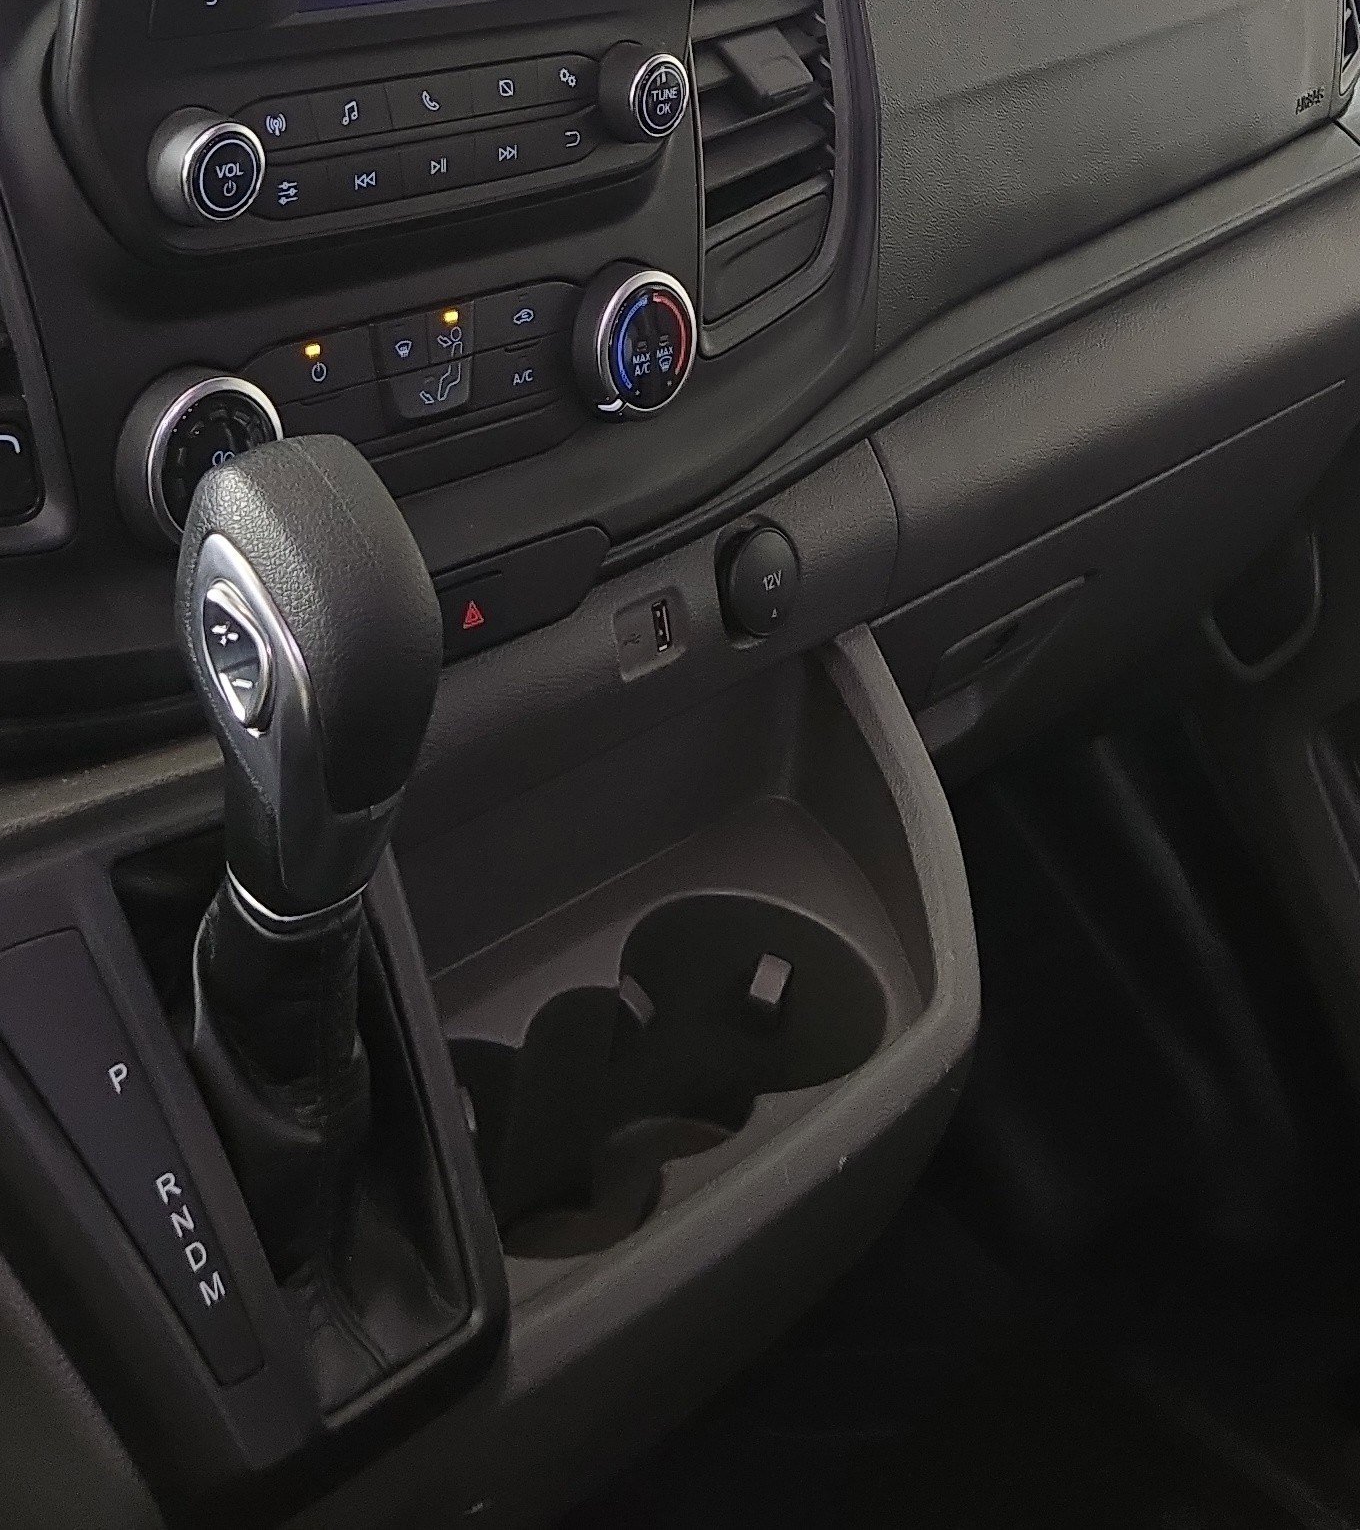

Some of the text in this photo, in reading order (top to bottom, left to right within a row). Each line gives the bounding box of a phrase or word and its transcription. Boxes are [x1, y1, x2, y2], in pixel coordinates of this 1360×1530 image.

[651, 86, 678, 102] TUNE
[656, 102, 672, 116] OK
[216, 160, 244, 179] VOL
[633, 351, 651, 365] MAX
[656, 346, 674, 358] MAX
[512, 368, 534, 385] A/C
[634, 362, 651, 376] A/C
[763, 570, 782, 591] 12V
[108, 1062, 128, 1094] P
[155, 1172, 182, 1205] R
[169, 1205, 194, 1238] N
[184, 1241, 207, 1272] D
[199, 1271, 226, 1306] M
